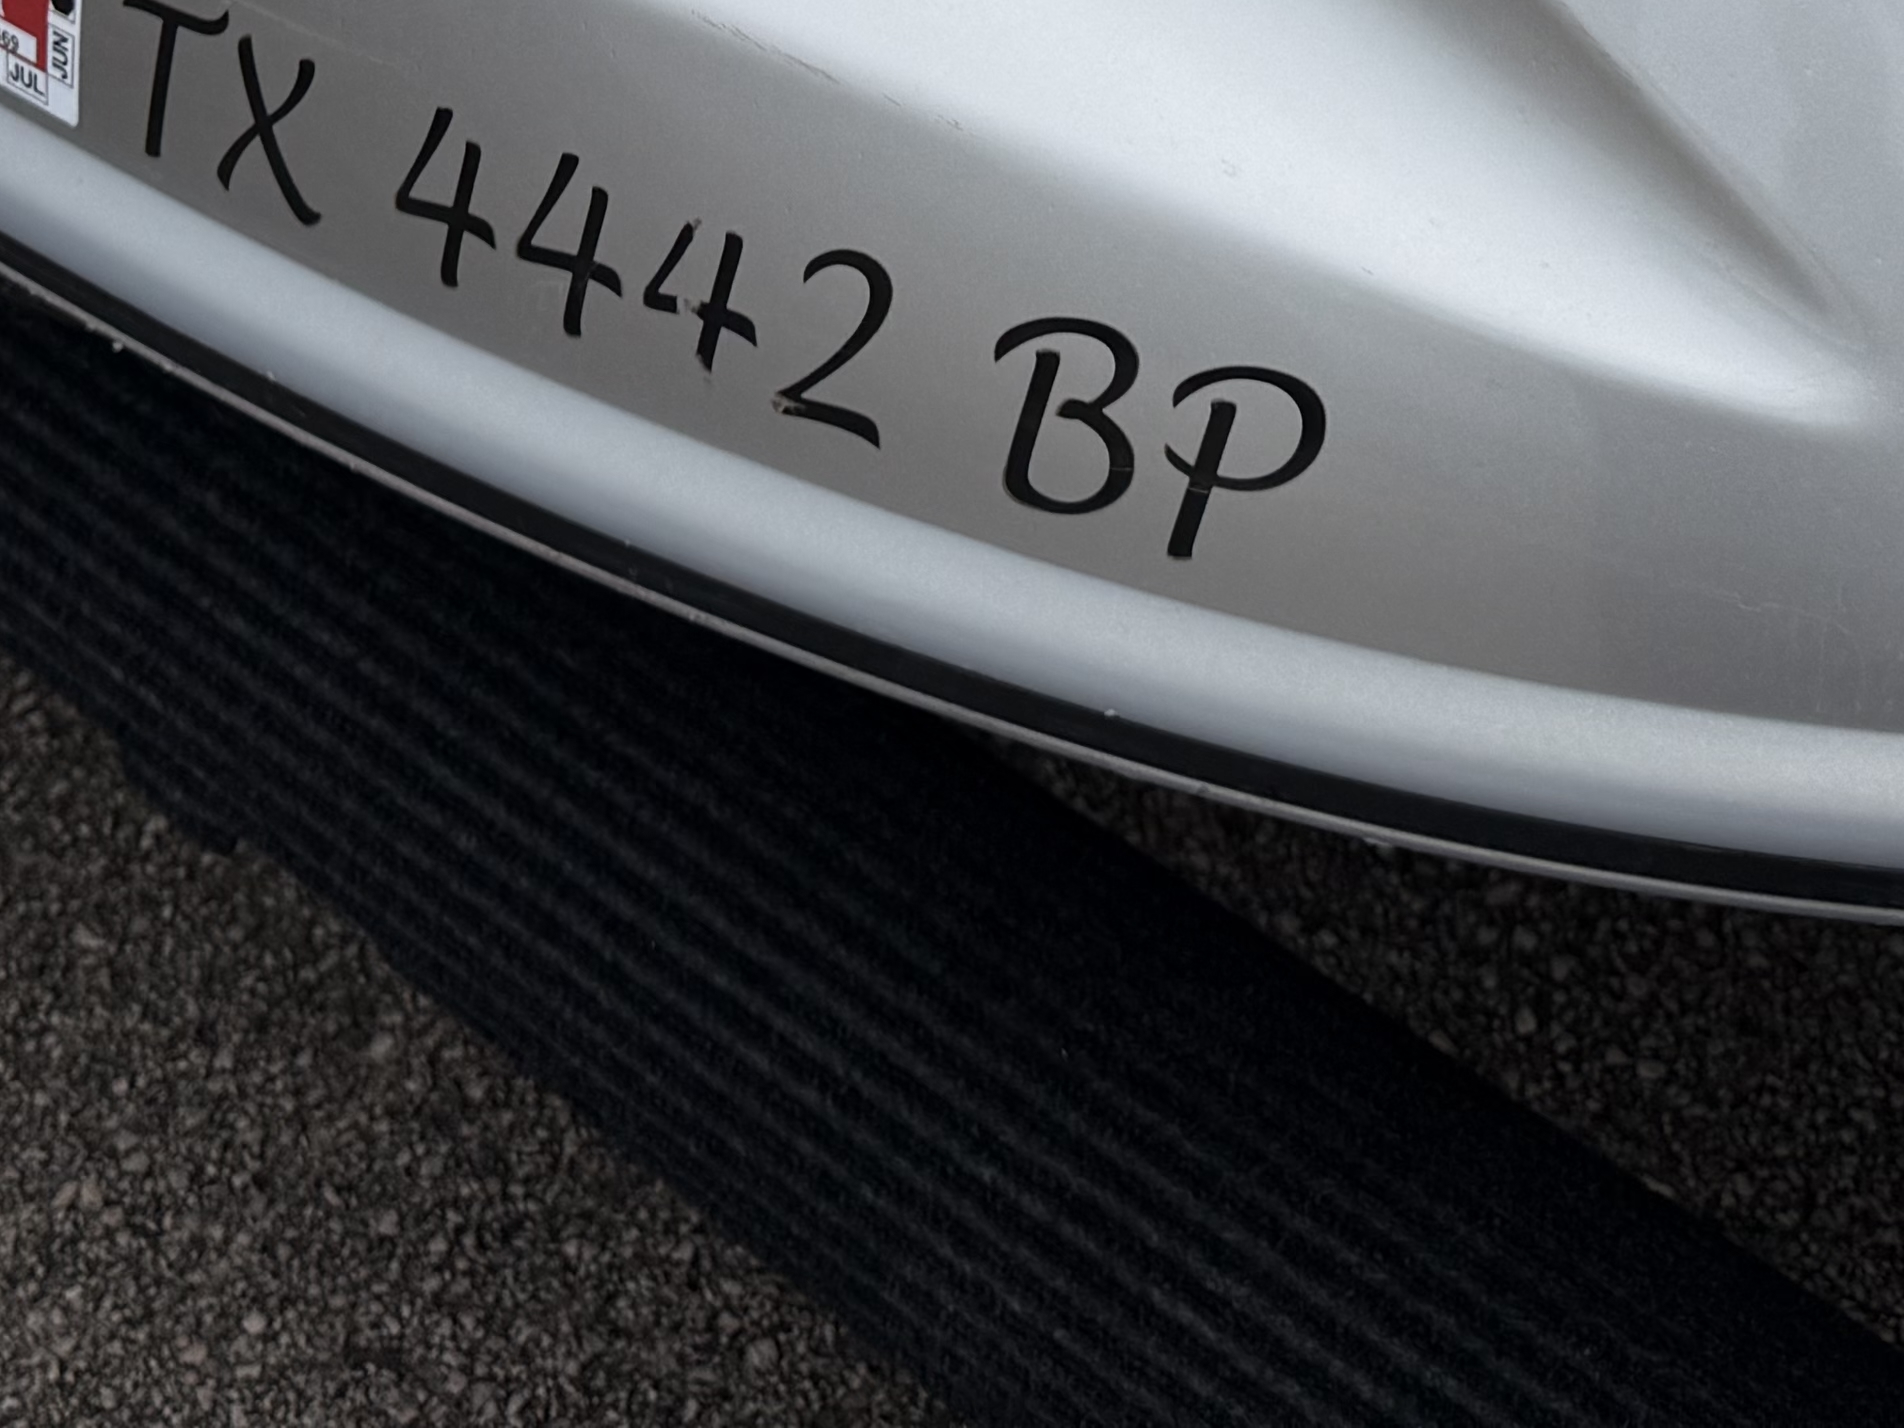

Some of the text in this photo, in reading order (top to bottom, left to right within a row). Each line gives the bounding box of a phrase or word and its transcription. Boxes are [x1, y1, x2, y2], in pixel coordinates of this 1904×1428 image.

[9, 62, 46, 96] JUL
[51, 30, 69, 81] JUN
[393, 106, 894, 450] 4442
[992, 315, 1328, 561] BP
